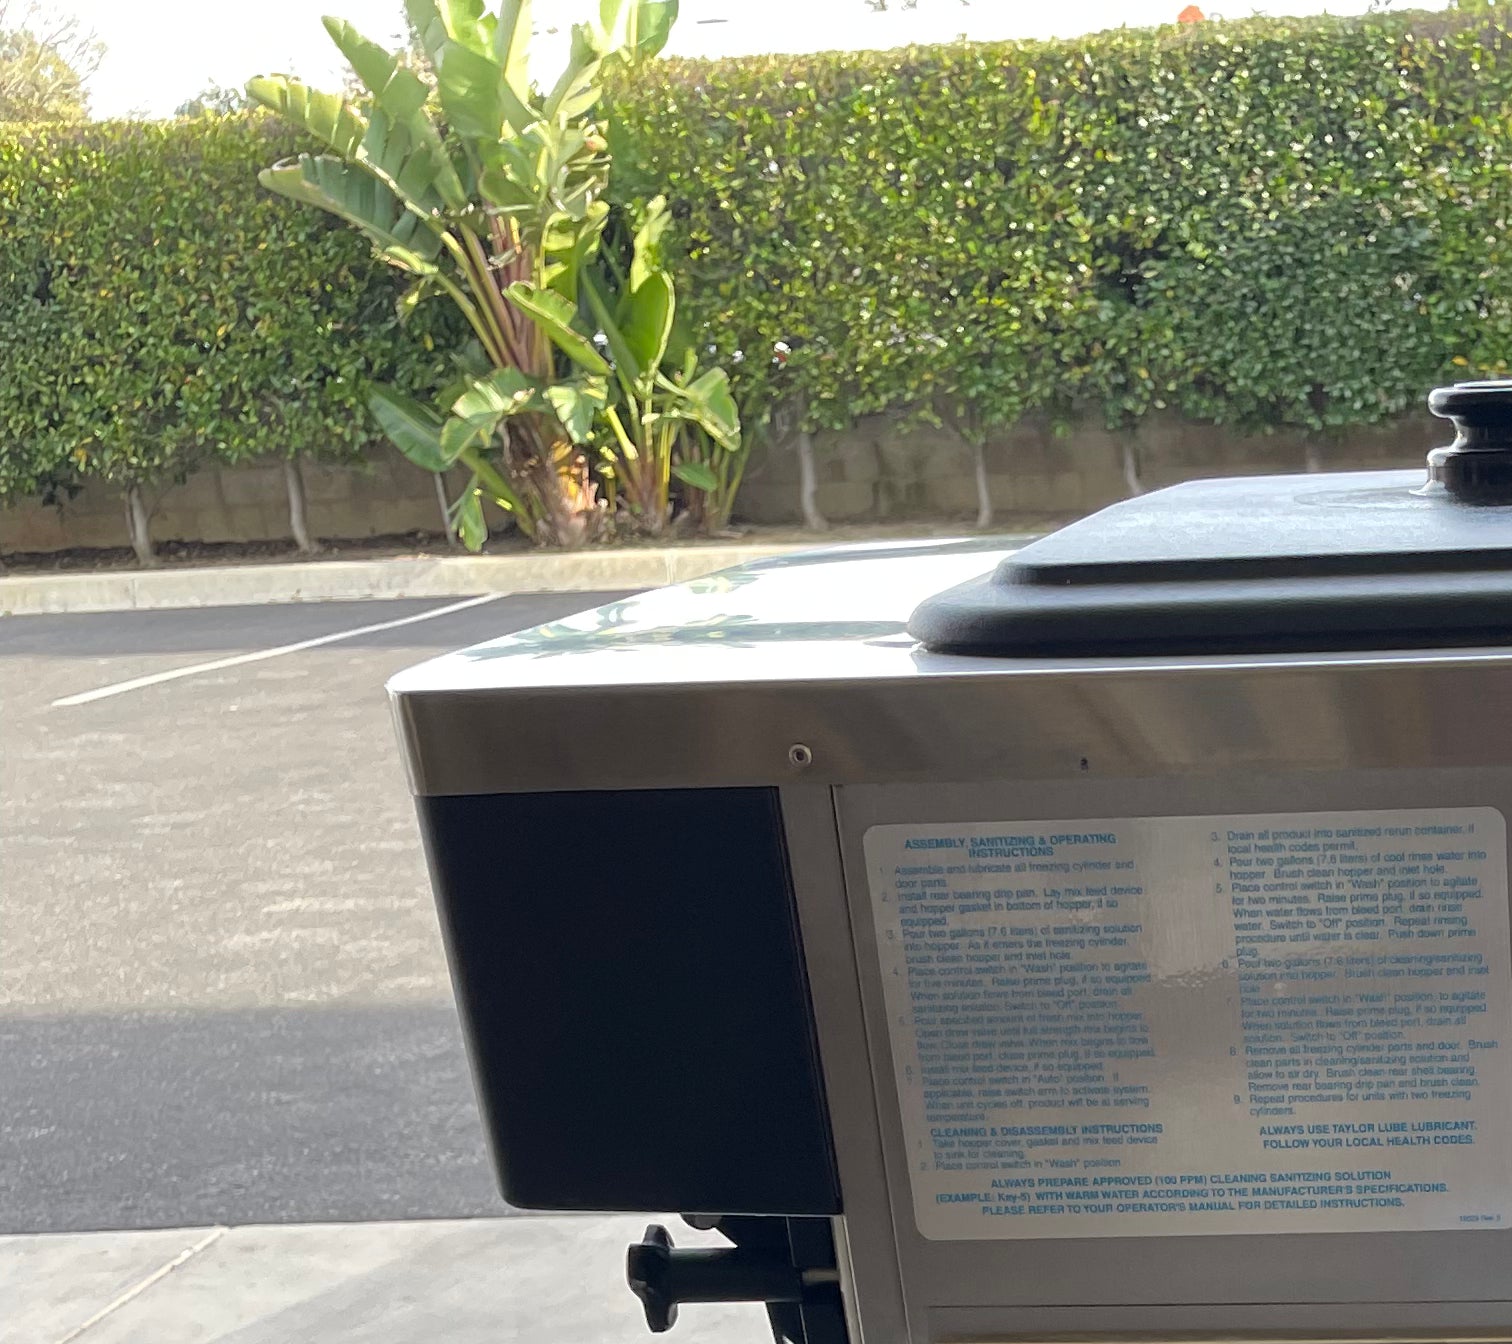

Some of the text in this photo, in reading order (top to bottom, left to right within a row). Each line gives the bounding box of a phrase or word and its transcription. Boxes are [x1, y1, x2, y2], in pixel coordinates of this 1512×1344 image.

[1038, 835, 1046, 846] &
[1049, 832, 1116, 845] OPERATING
[968, 845, 1054, 858] INSTRUCTIONS
[990, 1127, 997, 1136] &
[1081, 1123, 1162, 1134] INSTRUCTIONS
[1259, 1124, 1304, 1135] ALWAYS
[1307, 1123, 1330, 1134] USE
[1332, 1122, 1374, 1133] TAYLOR
[1377, 1121, 1407, 1132] LUBE
[1263, 1138, 1309, 1149] FOLLOW
[1311, 1137, 1342, 1148] YOUR
[1345, 1136, 1383, 1147] LOCAL
[1386, 1135, 1430, 1146] HEALTH
[991, 1177, 1035, 1188] ALWAYS
[1037, 1176, 1088, 1187] PREPARE
[1092, 1175, 1152, 1186] APPROVED
[1334, 1170, 1391, 1181] SOLUTION
[982, 1204, 1024, 1215] PLEASE
[1028, 1204, 1064, 1214] REFER
[1066, 1203, 1081, 1213] TO
[1083, 1203, 1112, 1213] YOUR
[1115, 1201, 1186, 1212] OPERATOR'S
[1238, 1200, 1260, 1210] FOR
[1263, 1199, 1317, 1209] DETAILED
